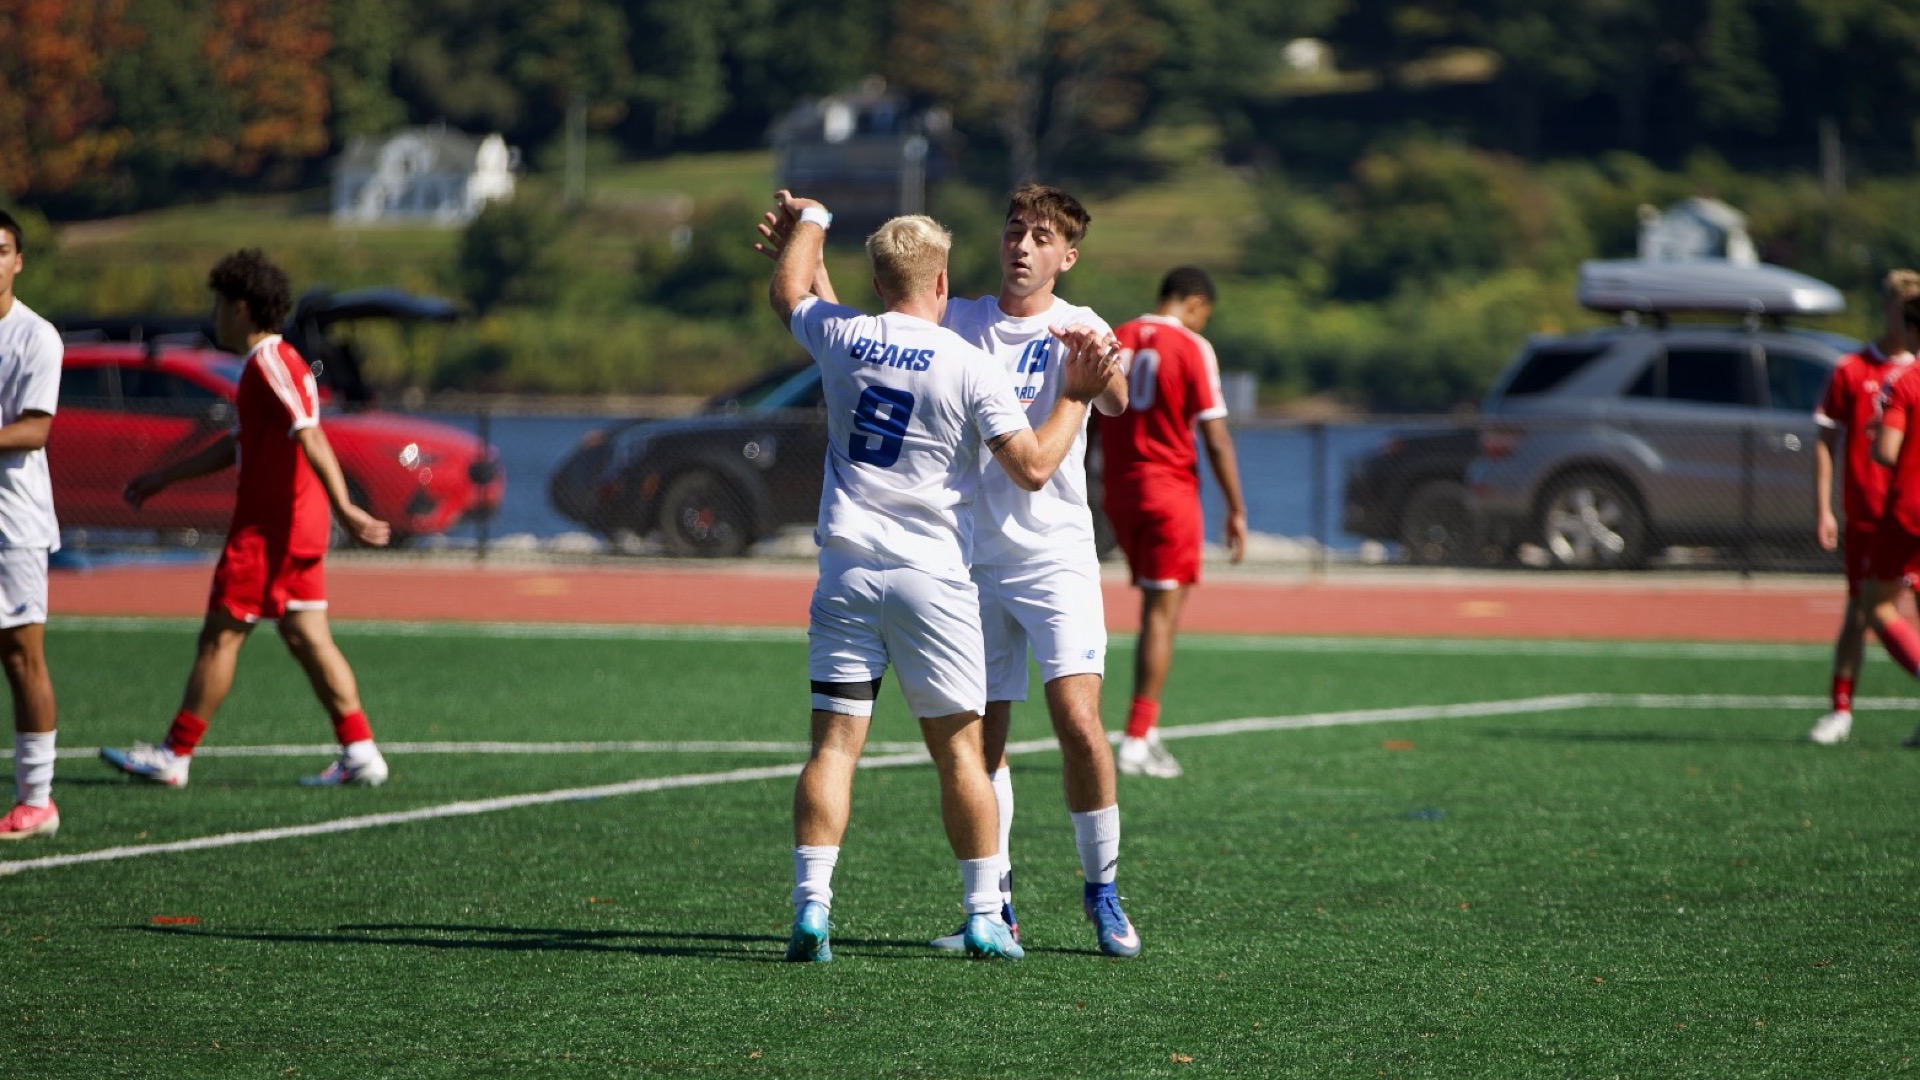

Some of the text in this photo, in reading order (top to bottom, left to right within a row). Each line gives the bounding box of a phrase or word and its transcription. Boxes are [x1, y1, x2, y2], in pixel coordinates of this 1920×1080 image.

[849, 335, 935, 372] BEARS
[1016, 334, 1054, 375] 15
[1119, 346, 1162, 412] 0
[848, 385, 915, 468] 9
